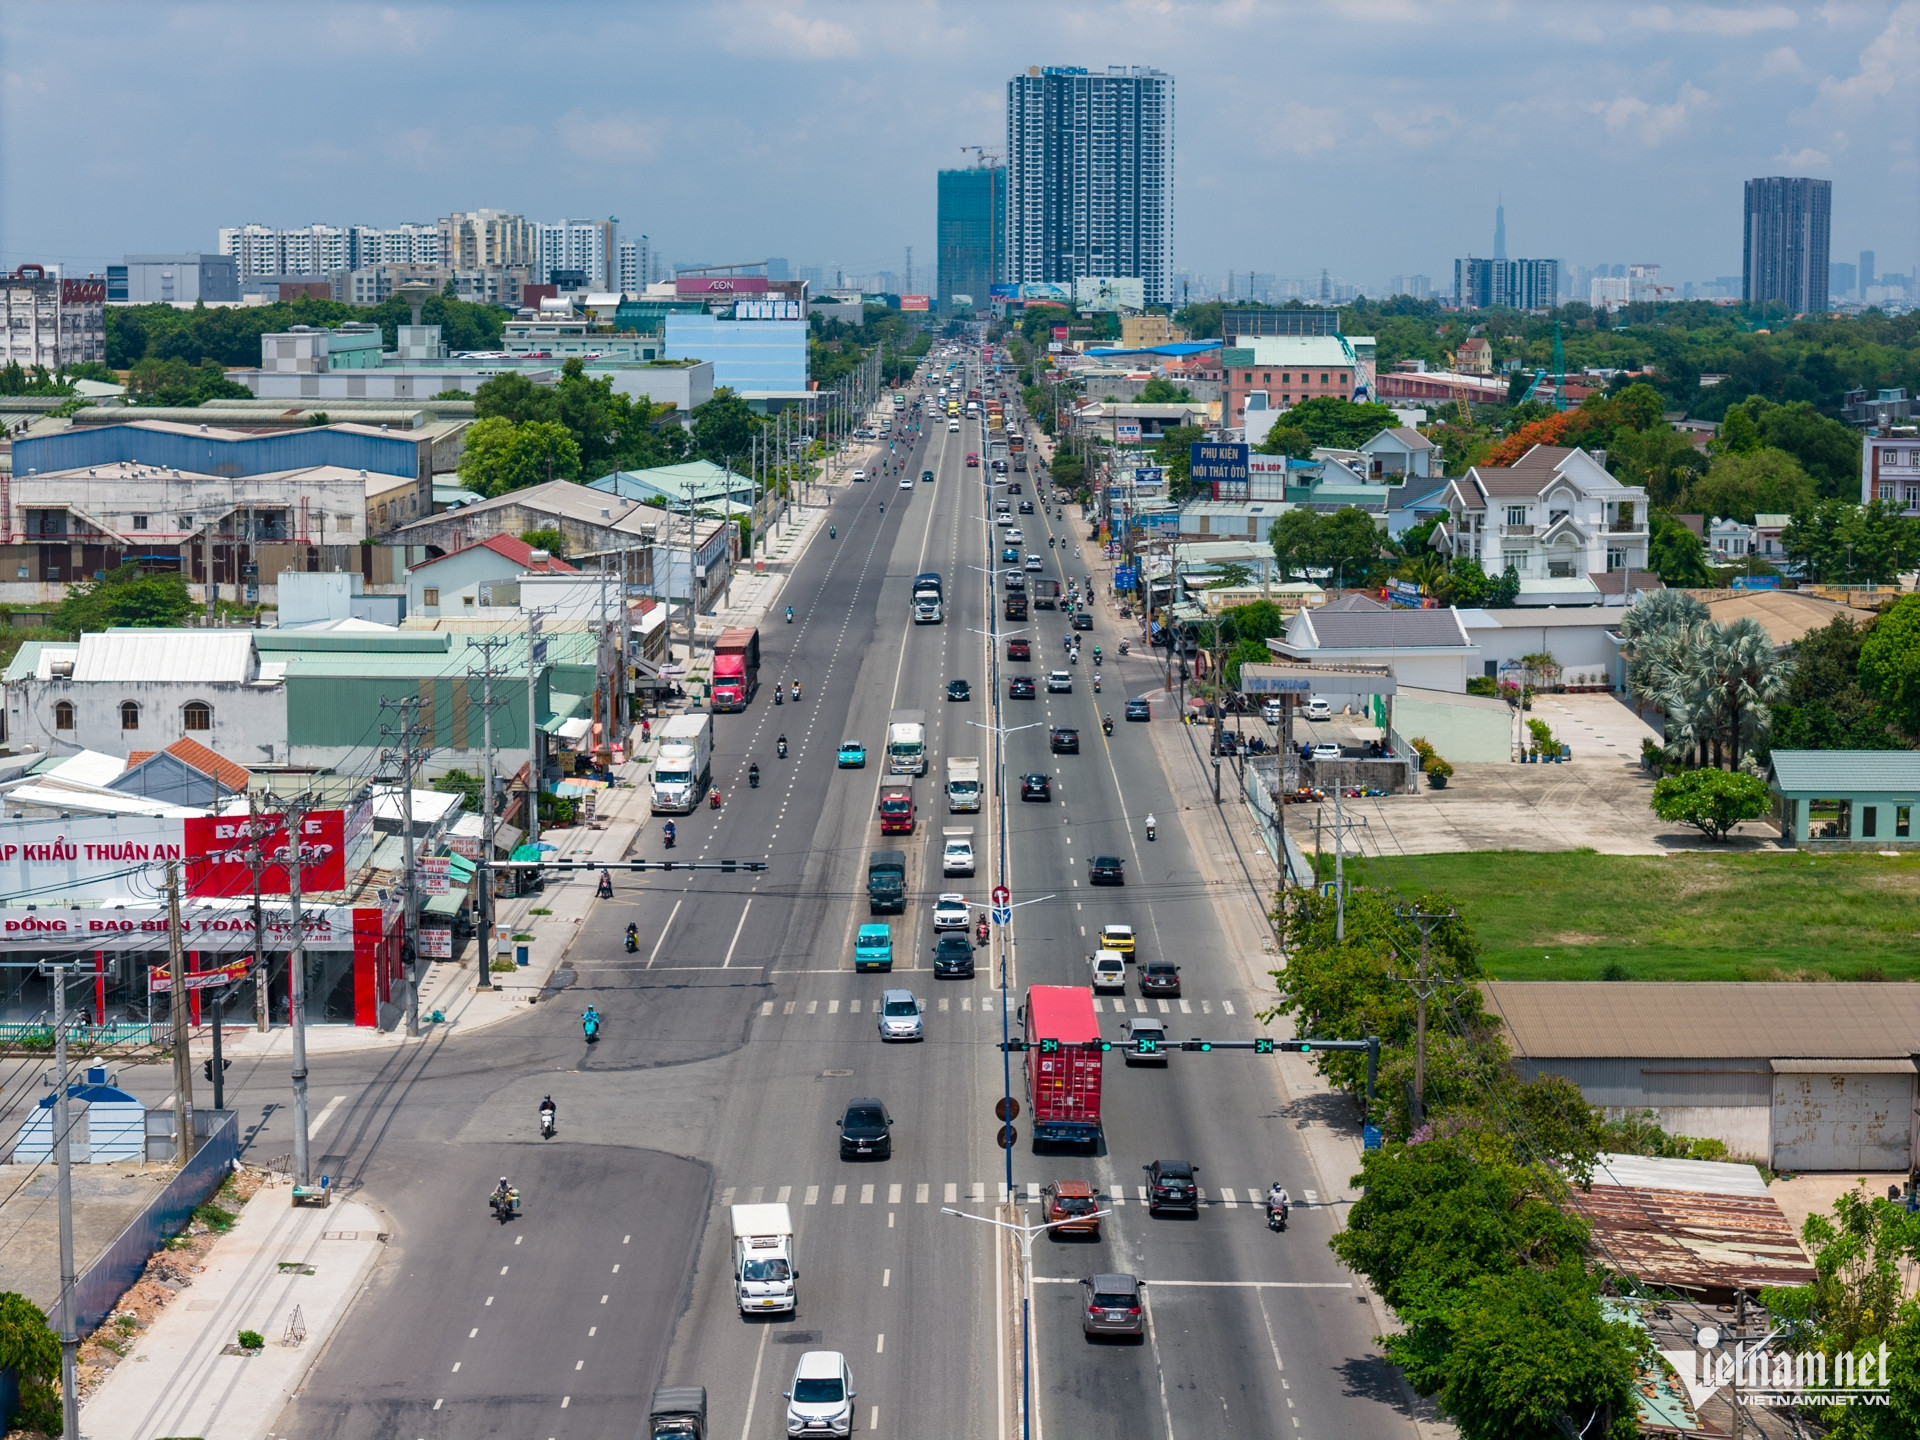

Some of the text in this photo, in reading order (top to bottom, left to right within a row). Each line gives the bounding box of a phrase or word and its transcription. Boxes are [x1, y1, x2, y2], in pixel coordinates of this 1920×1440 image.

[1201, 446, 1239, 462] PHỤ KIỆN
[1192, 463, 1207, 480] NỘI
[1209, 462, 1229, 478] THẤT
[1250, 461, 1282, 472] TRẢ GÓP
[23, 835, 78, 861] KHẨU
[84, 840, 149, 864] THUẬN
[153, 843, 181, 861] AN
[89, 920, 133, 931] BAO
[197, 917, 257, 932] TOÀN
[1041, 1039, 1272, 1052] 34 34 34
